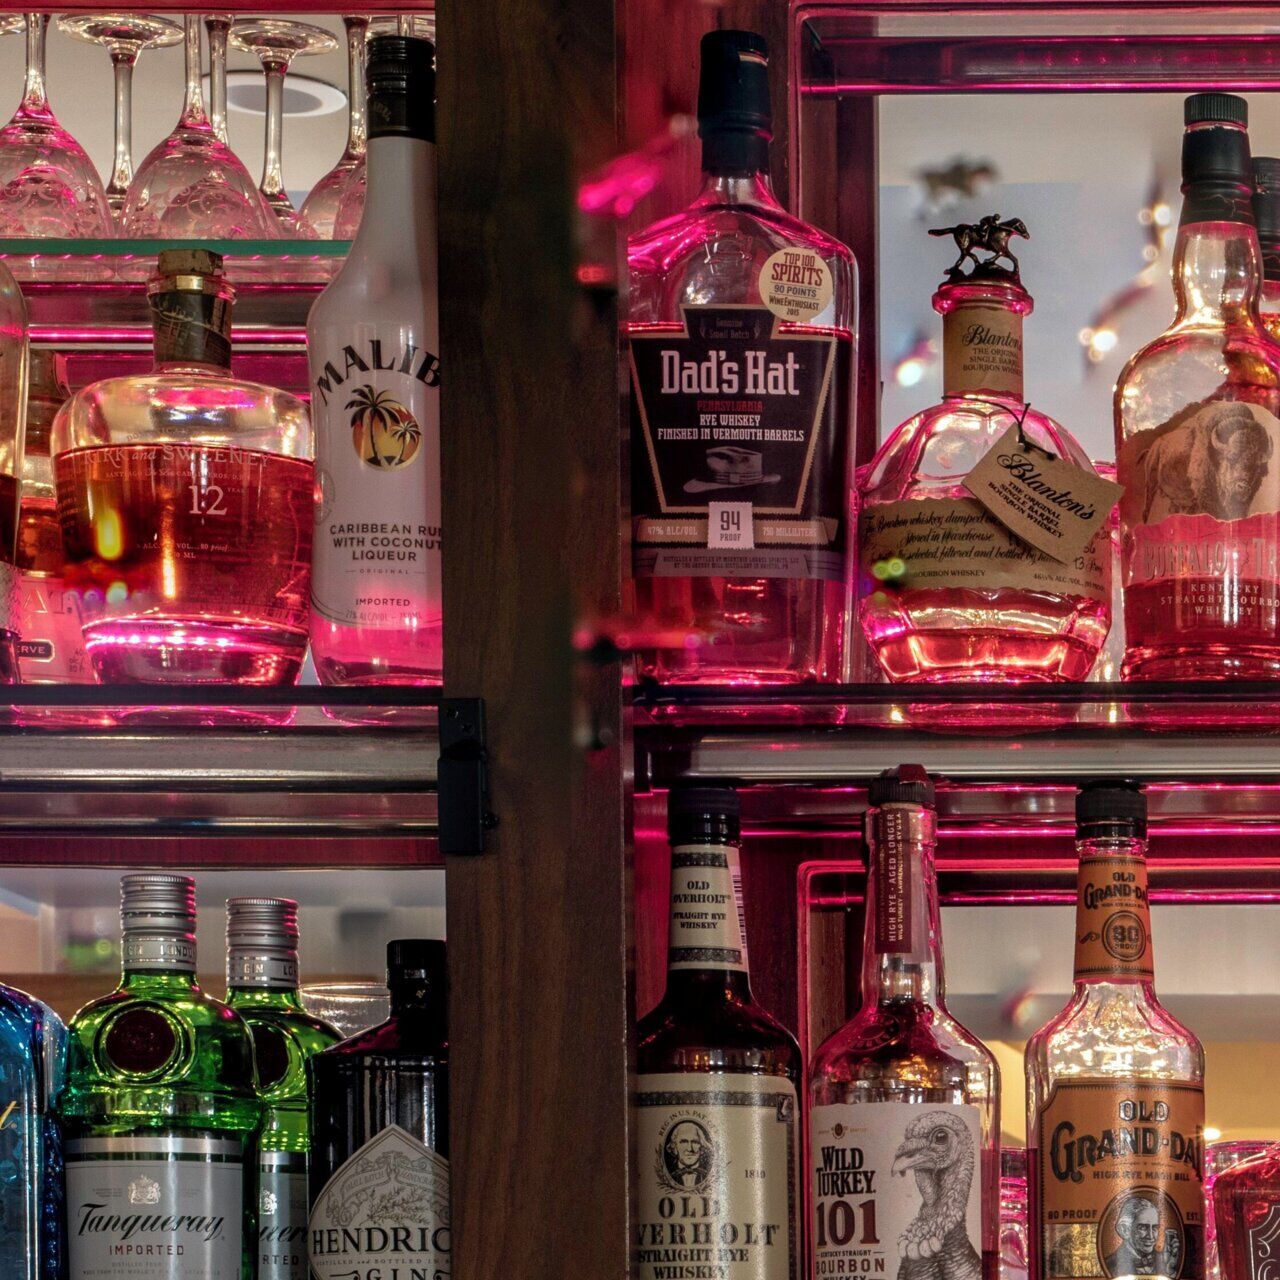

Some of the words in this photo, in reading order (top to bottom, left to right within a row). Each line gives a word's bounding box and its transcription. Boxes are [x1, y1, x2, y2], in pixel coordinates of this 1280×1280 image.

[784, 252, 800, 266] TOP
[801, 254, 815, 267] 100
[771, 265, 824, 287] SPIRITS
[774, 285, 784, 294] 90
[786, 287, 817, 297] POINTS
[661, 350, 739, 394] Dad's
[745, 351, 800, 395] Hat
[700, 415, 717, 426] RYE
[720, 415, 761, 427] WHISKEY
[658, 429, 698, 440] FINISHED
[700, 429, 711, 440] IN
[713, 429, 763, 441] VERMOUTH
[764, 430, 804, 442] BARRELS
[996, 452, 1096, 521] Blanton's
[188, 484, 228, 516] 12
[720, 510, 741, 531] 94
[330, 523, 412, 536] CARIBBEAN
[720, 533, 741, 542] PROOF
[333, 536, 365, 548] WITH
[370, 537, 442, 550] COCONUT
[352, 550, 417, 562] LIQUEUR
[1143, 538, 1227, 579] BUFFALO
[355, 598, 411, 607] IMPORTED
[687, 880, 710, 890] OLD
[1119, 1099, 1169, 1123] OLD
[821, 1146, 864, 1171] WILD
[816, 1168, 874, 1198] TURKEY
[658, 1197, 721, 1219] OLD
[78, 1203, 224, 1241] Tanqueray
[816, 1200, 880, 1246] 101
[312, 1227, 450, 1255] HENDRIC
[109, 1245, 184, 1255] IMPORTED
[638, 1249, 711, 1262] STRAIGHT
[653, 1266, 730, 1280] WHISKEY
[816, 1258, 885, 1274] BOURBON
